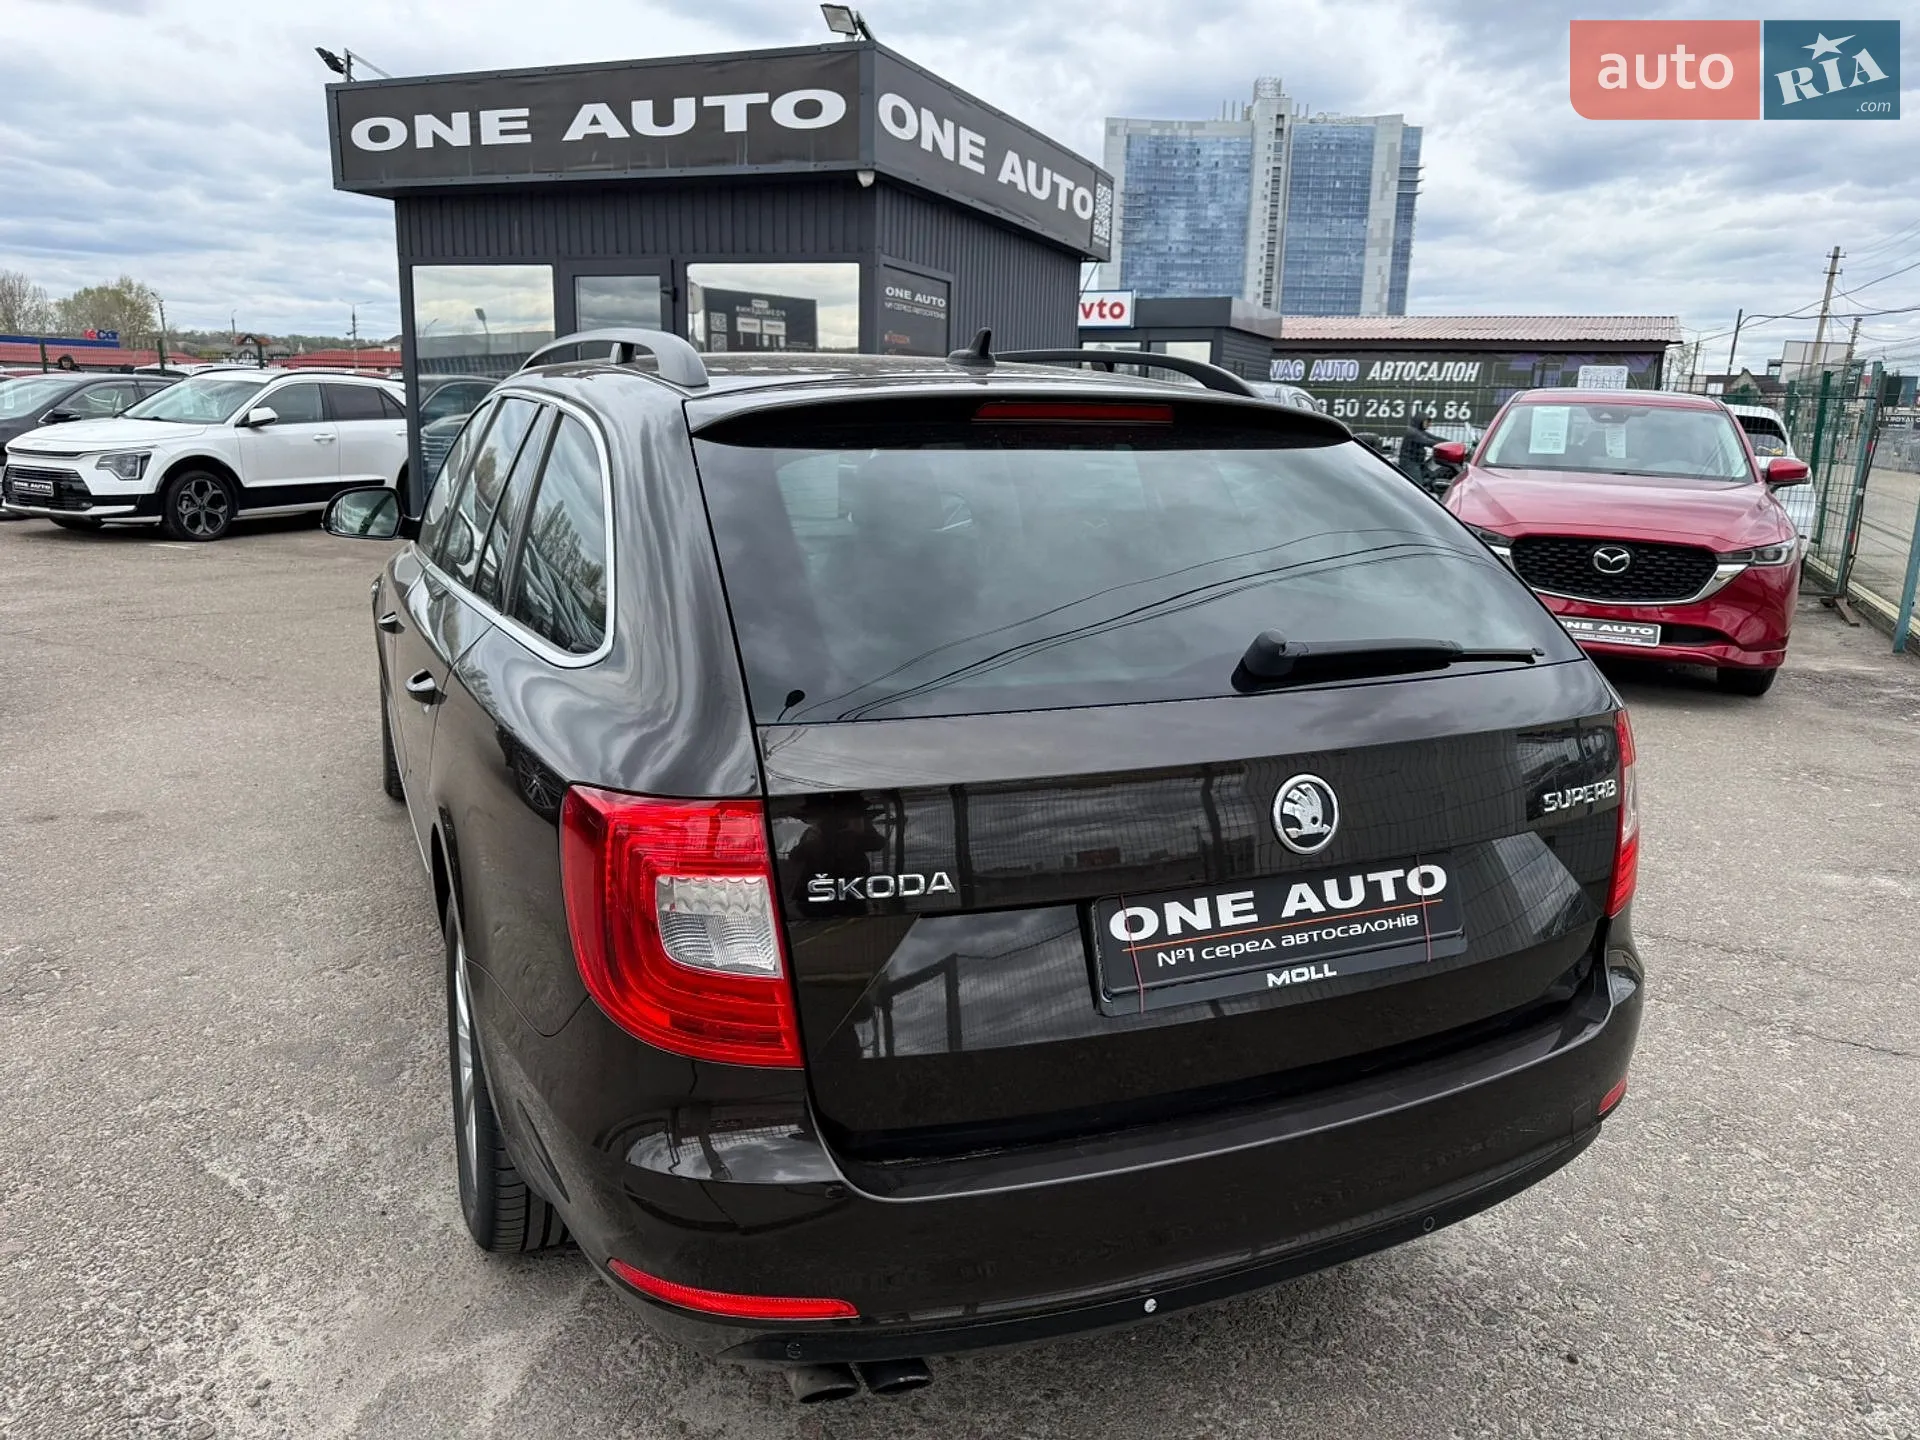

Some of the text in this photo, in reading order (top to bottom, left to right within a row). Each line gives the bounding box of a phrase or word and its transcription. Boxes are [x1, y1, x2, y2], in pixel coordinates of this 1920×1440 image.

[350, 88, 847, 152] ONE AUTO
[877, 92, 1094, 221] ONE AUTO
[885, 286, 946, 308] ONE AUTO
[1270, 358, 1360, 382] VAG AUTO
[1366, 360, 1481, 383] АВТОСАЛОН
[1332, 398, 1360, 418] 50
[1364, 398, 1406, 419] 263
[1443, 400, 1472, 421] 86
[1598, 623, 1655, 636] AUTO
[1542, 778, 1617, 813] SUPERB
[807, 871, 956, 903] ŠKODA
[1108, 863, 1448, 943] ONE AUTO
[1200, 937, 1278, 960] серед
[1280, 912, 1420, 948] автосалонів
[1265, 963, 1338, 988] MOLL
